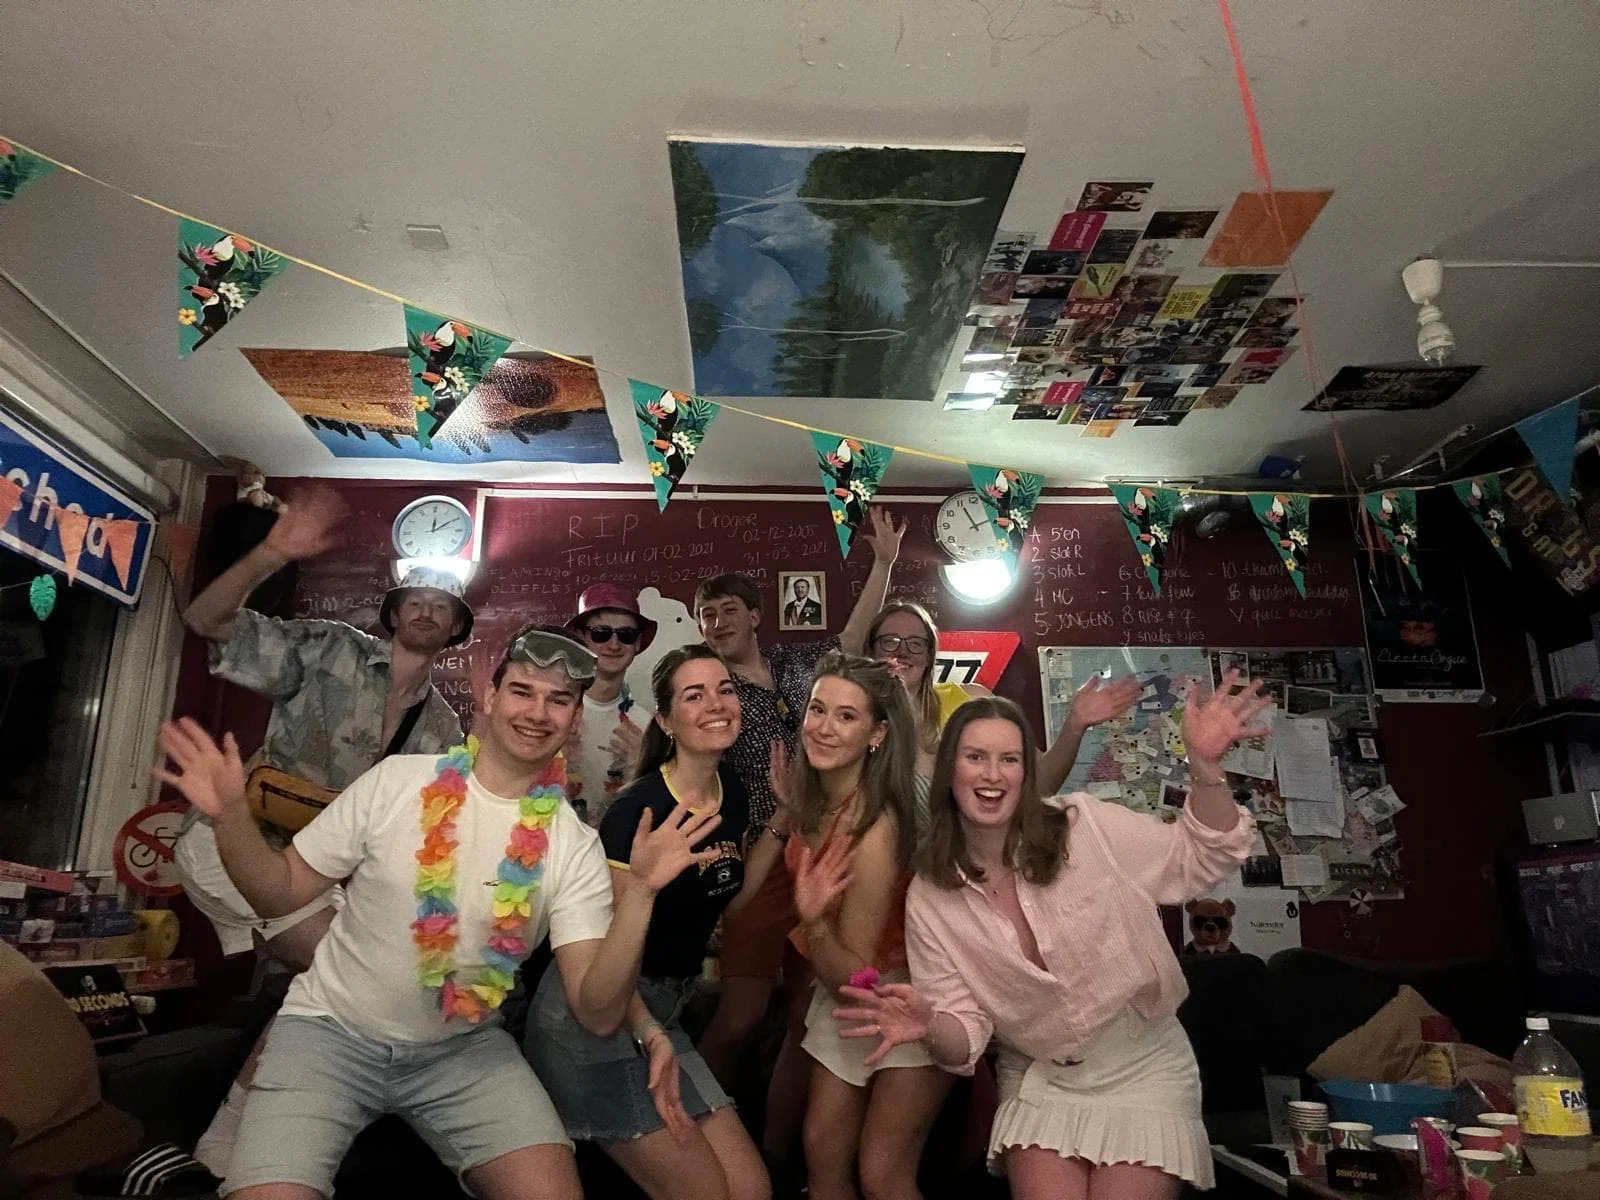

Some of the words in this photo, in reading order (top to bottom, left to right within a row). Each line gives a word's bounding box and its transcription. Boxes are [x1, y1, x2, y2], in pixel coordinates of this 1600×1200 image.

[957, 499, 963, 507] 11
[968, 496, 979, 504] 12
[942, 522, 950, 530] 9
[1029, 526, 1041, 544] A
[947, 535, 956, 543] 8
[1032, 546, 1045, 562] 2
[1074, 544, 1084, 559] R
[1033, 565, 1045, 584] 3
[1034, 585, 1044, 608] 4
[1034, 611, 1050, 636] 5
[1122, 605, 1135, 624] 8
